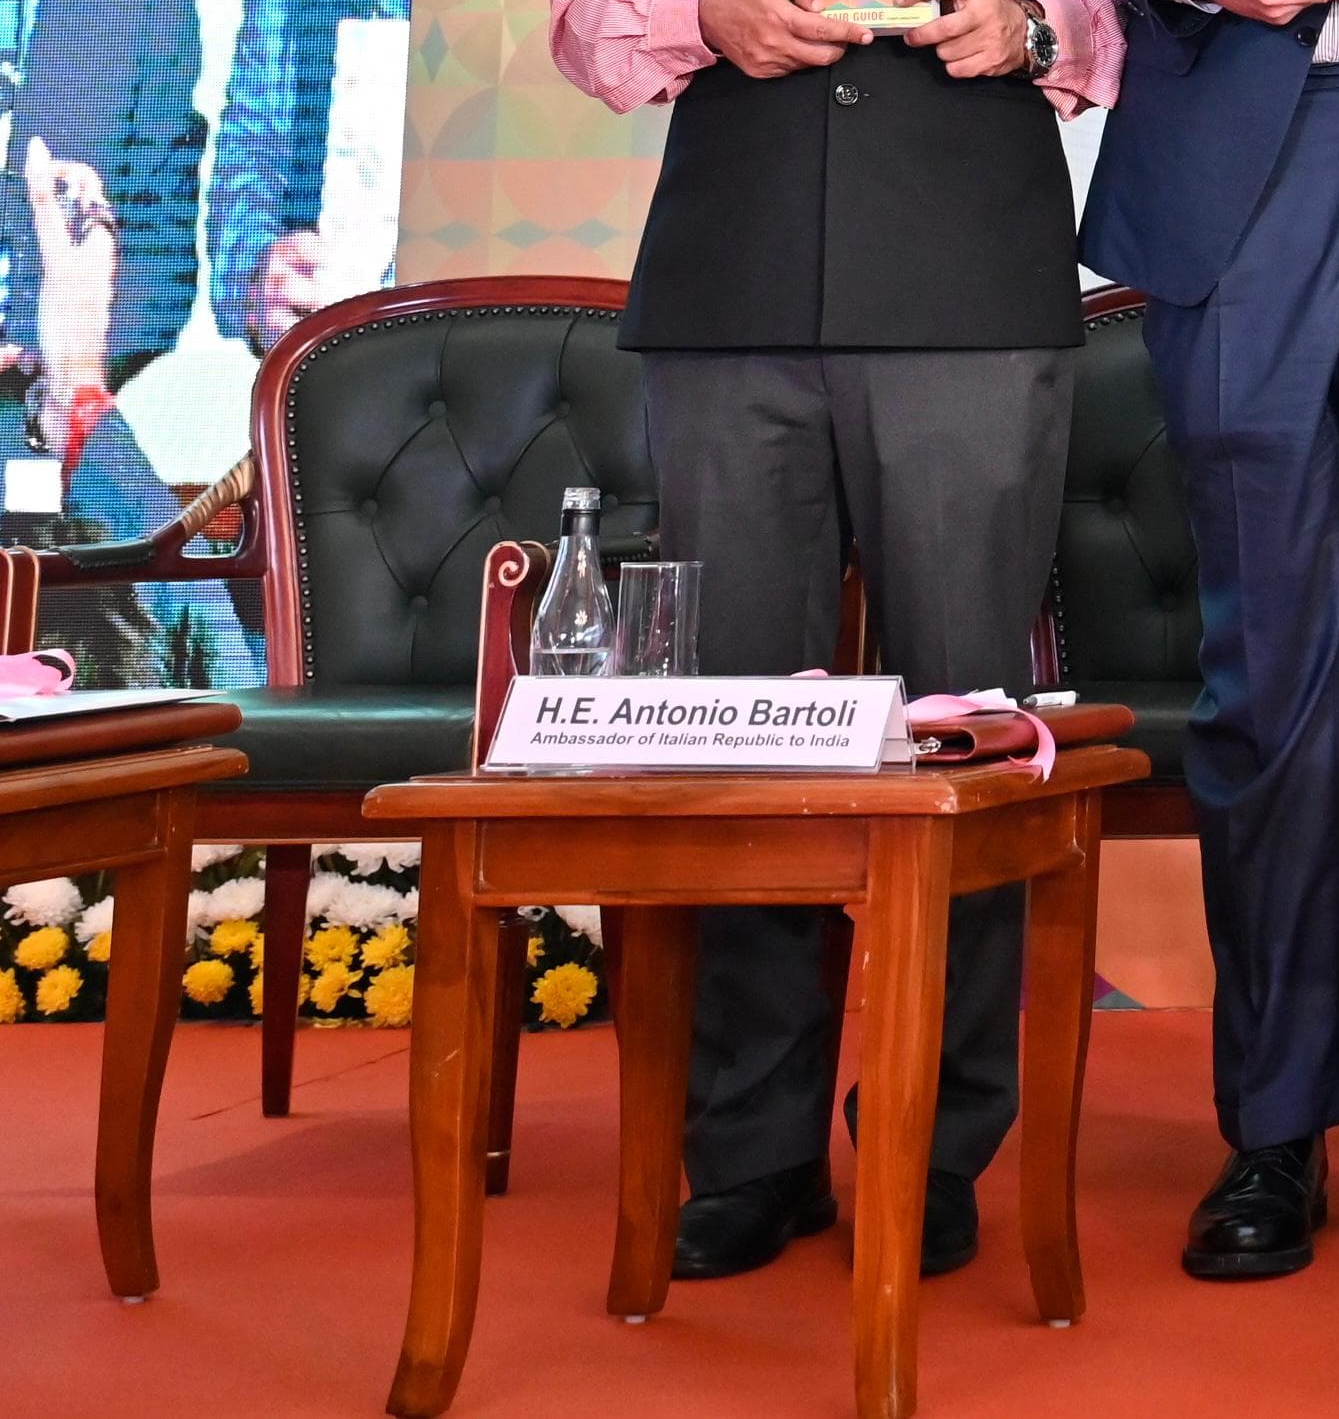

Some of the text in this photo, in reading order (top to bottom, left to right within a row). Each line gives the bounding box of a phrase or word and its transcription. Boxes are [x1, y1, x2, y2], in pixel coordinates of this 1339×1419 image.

[853, 11, 885, 22] GUIDE
[536, 697, 856, 727] H.E. Antonio Bartoli
[530, 731, 850, 750] Ambassador of Italian Republic to India
